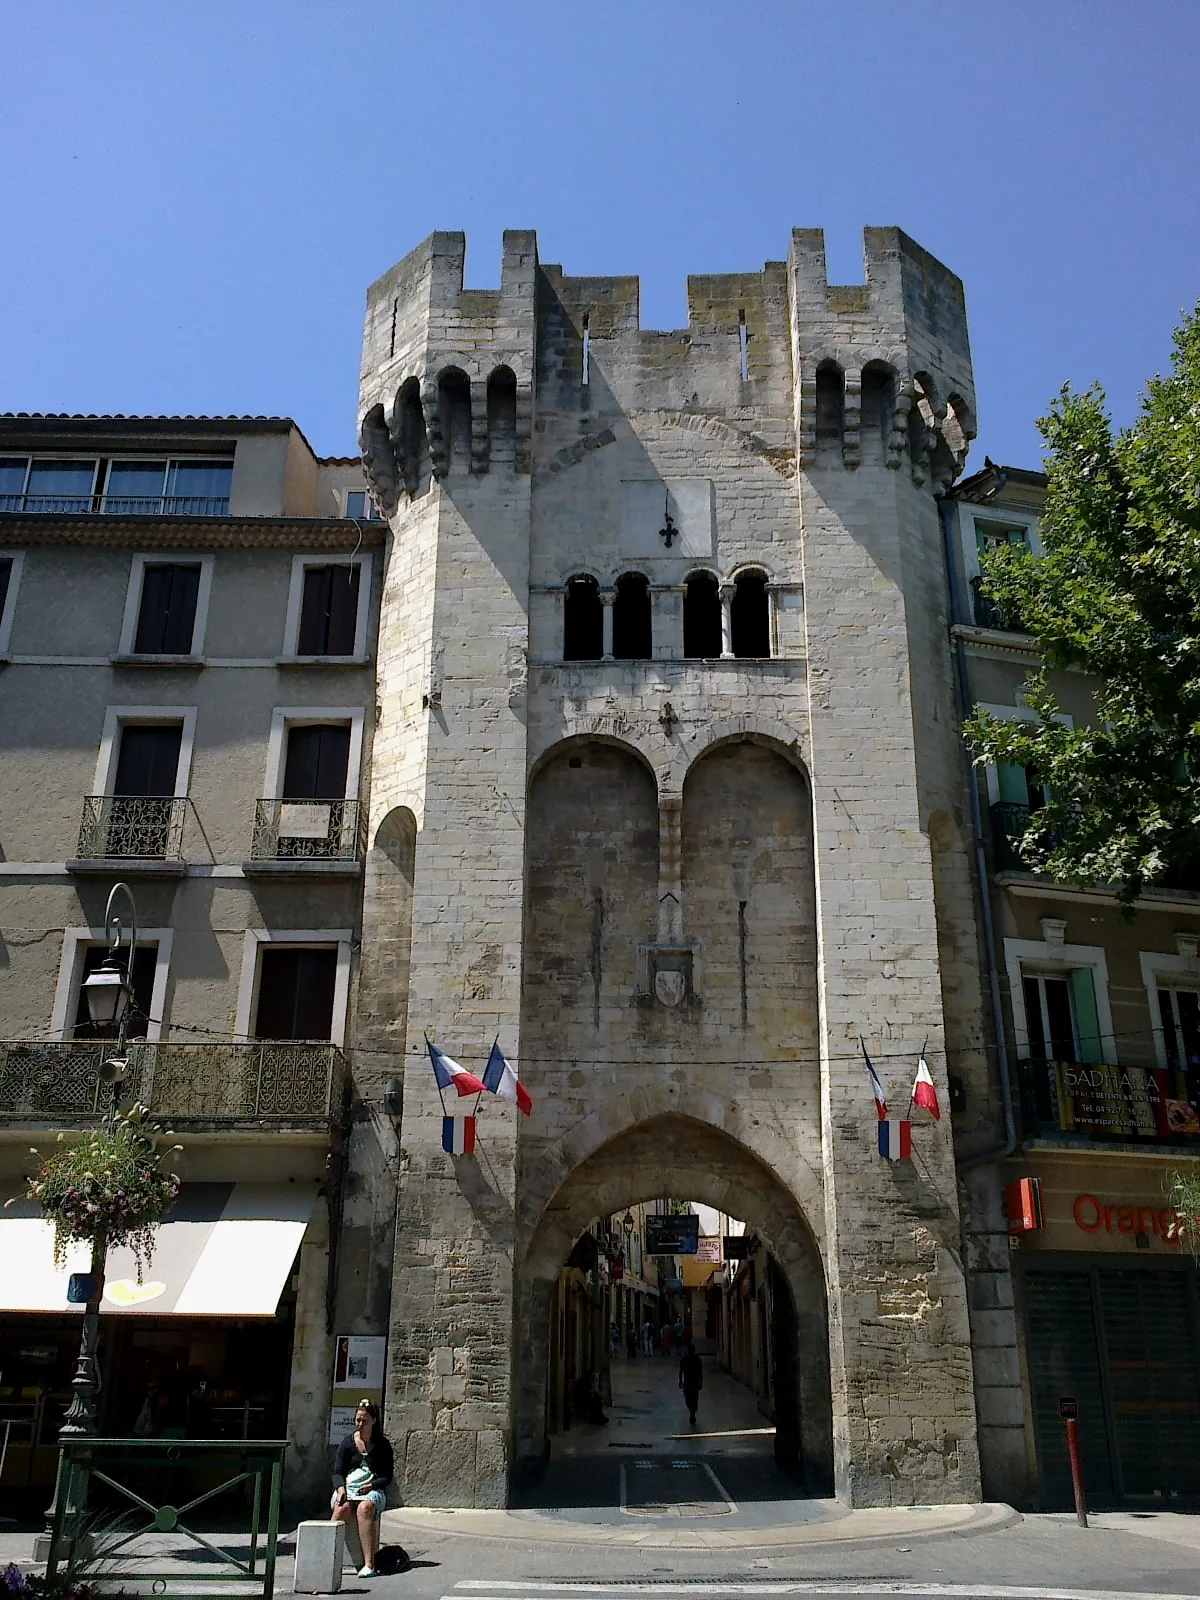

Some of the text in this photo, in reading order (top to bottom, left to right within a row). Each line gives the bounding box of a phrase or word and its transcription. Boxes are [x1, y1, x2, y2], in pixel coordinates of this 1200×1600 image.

[1064, 1068, 1160, 1092] SADHANA
[1065, 1089, 1095, 1098] ESPACE
[1073, 1194, 1199, 1245] Orang
